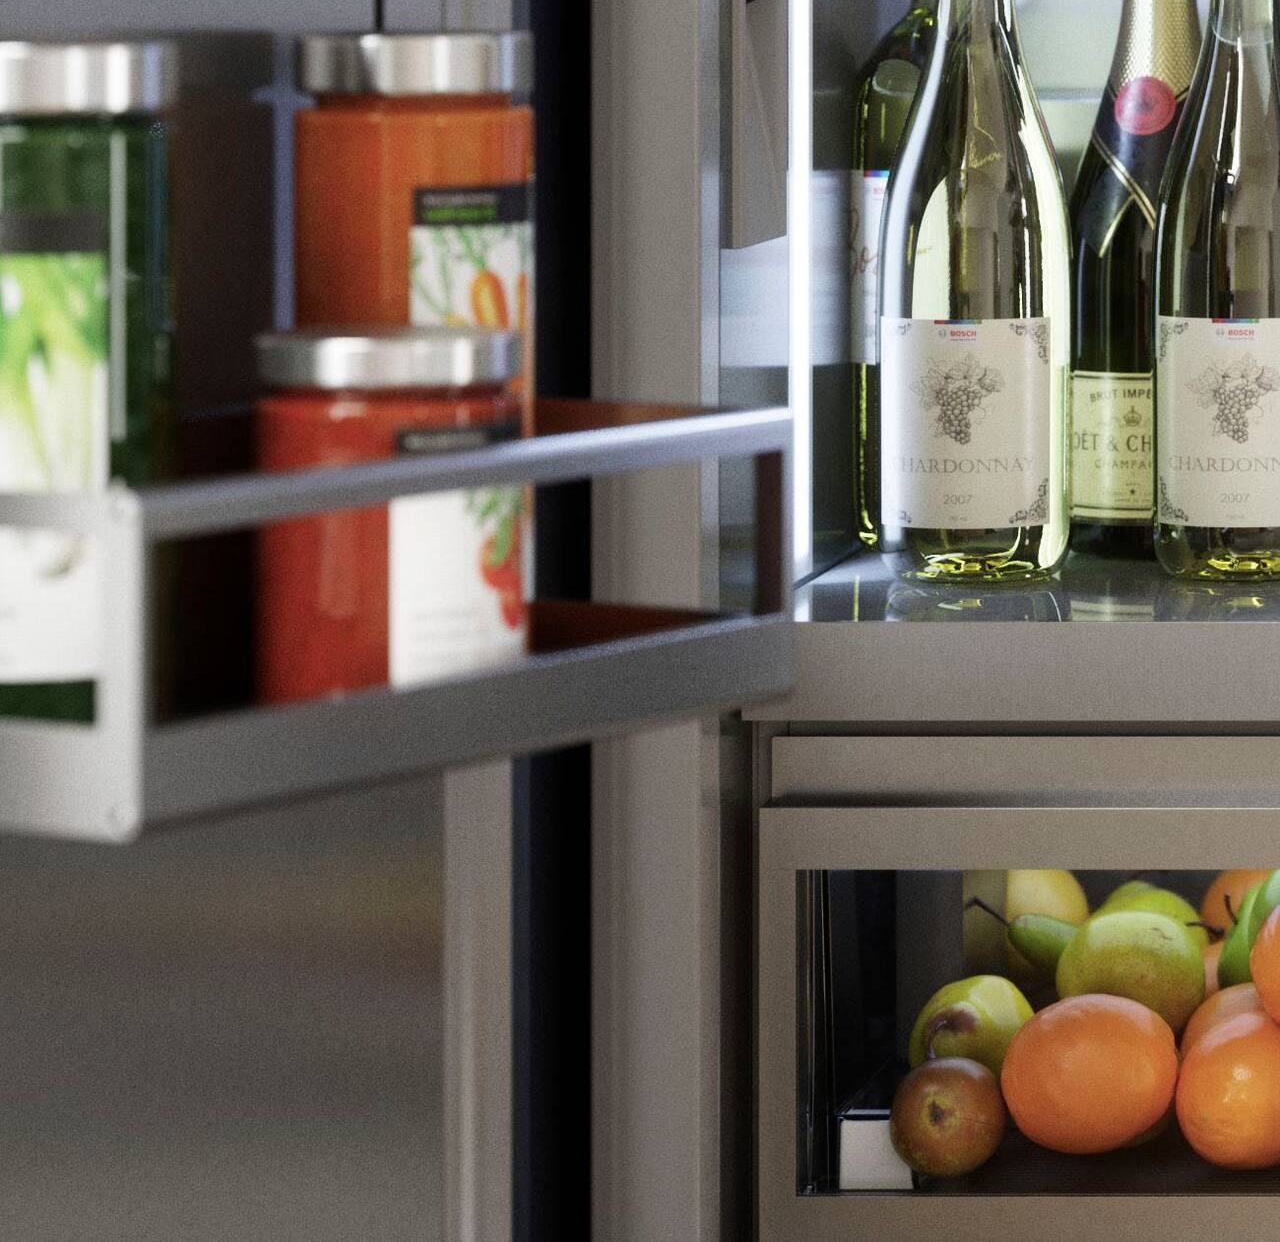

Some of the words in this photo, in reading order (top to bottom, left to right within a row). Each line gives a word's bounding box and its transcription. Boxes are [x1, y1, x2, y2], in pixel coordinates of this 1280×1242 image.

[950, 330, 977, 338] BOSCH
[1090, 389, 1118, 403] BRUT
[895, 458, 1035, 474] HARDONNAY
[1095, 460, 1151, 470] CAMPA
[943, 494, 973, 506] 2007
[1220, 492, 1250, 504] 2007
